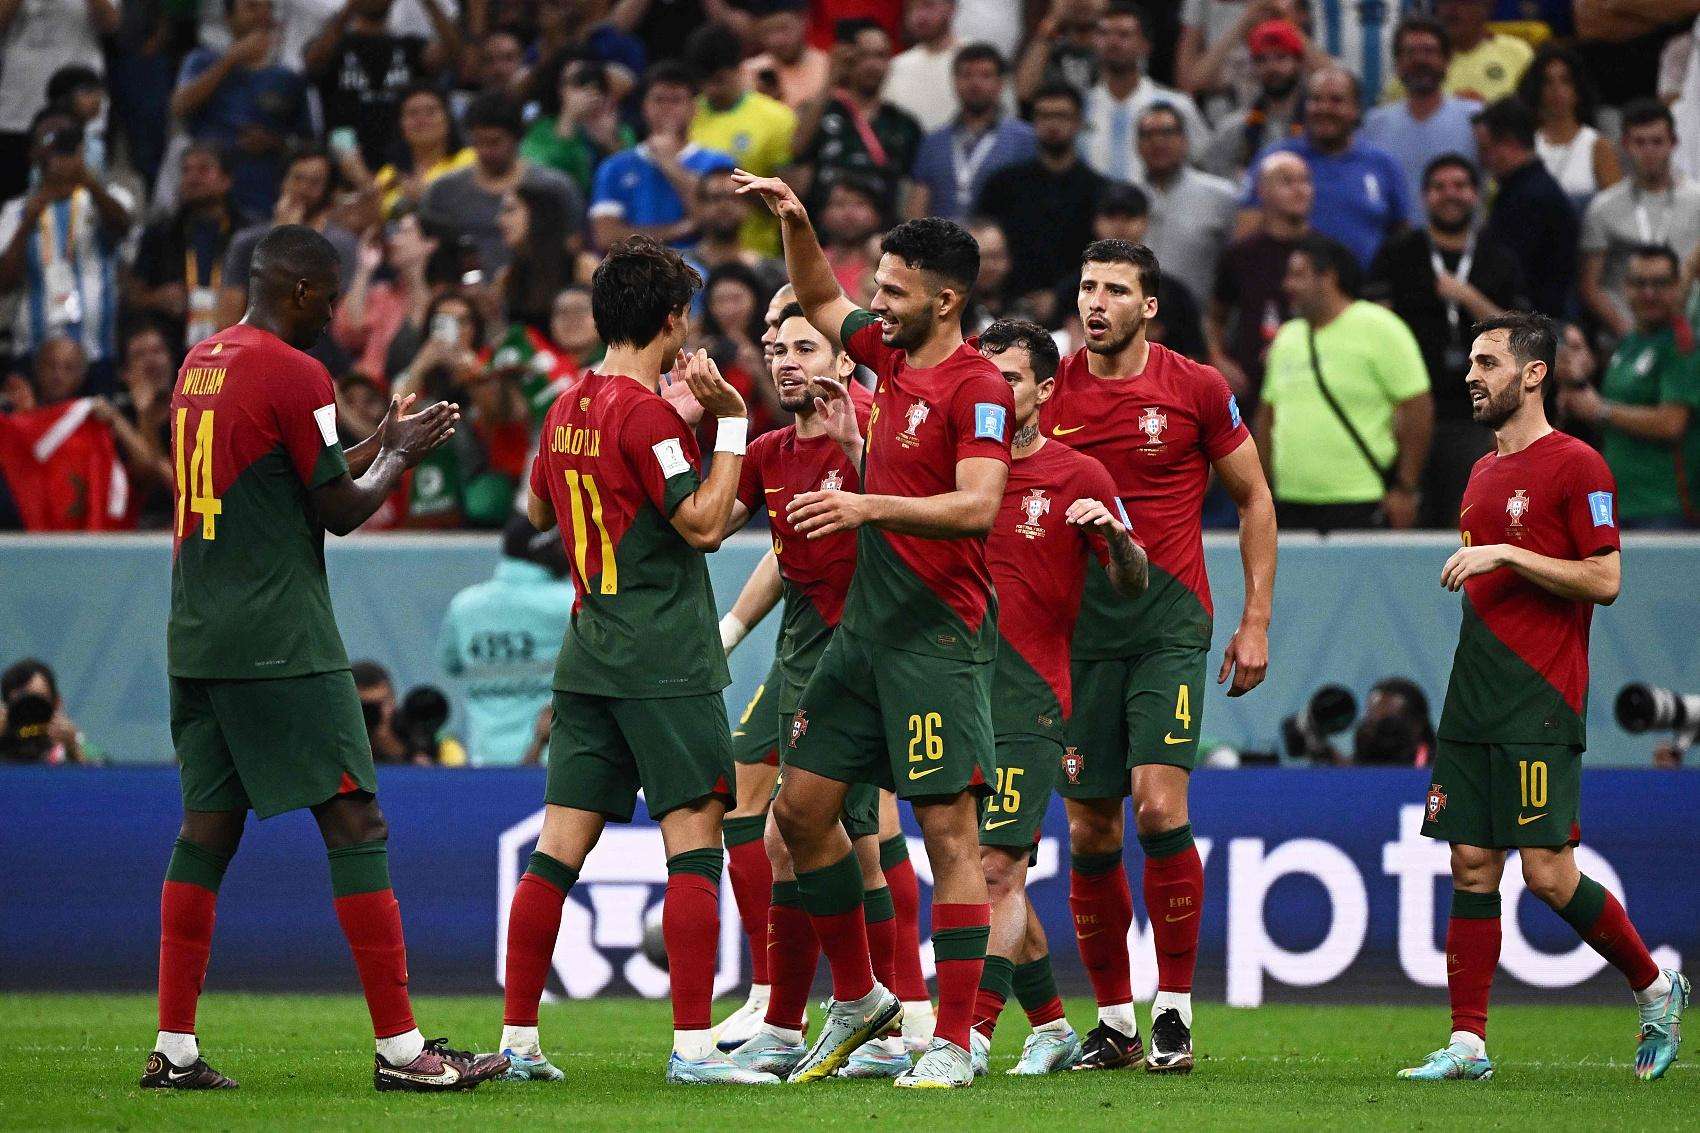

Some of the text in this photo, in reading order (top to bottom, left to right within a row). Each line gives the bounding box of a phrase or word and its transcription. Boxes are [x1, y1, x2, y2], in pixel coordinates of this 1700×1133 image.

[181, 367, 227, 396] WILLIAM
[551, 423, 584, 455] JOÃO
[176, 407, 222, 540] 14
[564, 469, 618, 595] 11
[1175, 684, 1191, 730] 4
[908, 711, 944, 763] 26
[987, 767, 1024, 814] 25
[1518, 760, 1548, 808] 10
